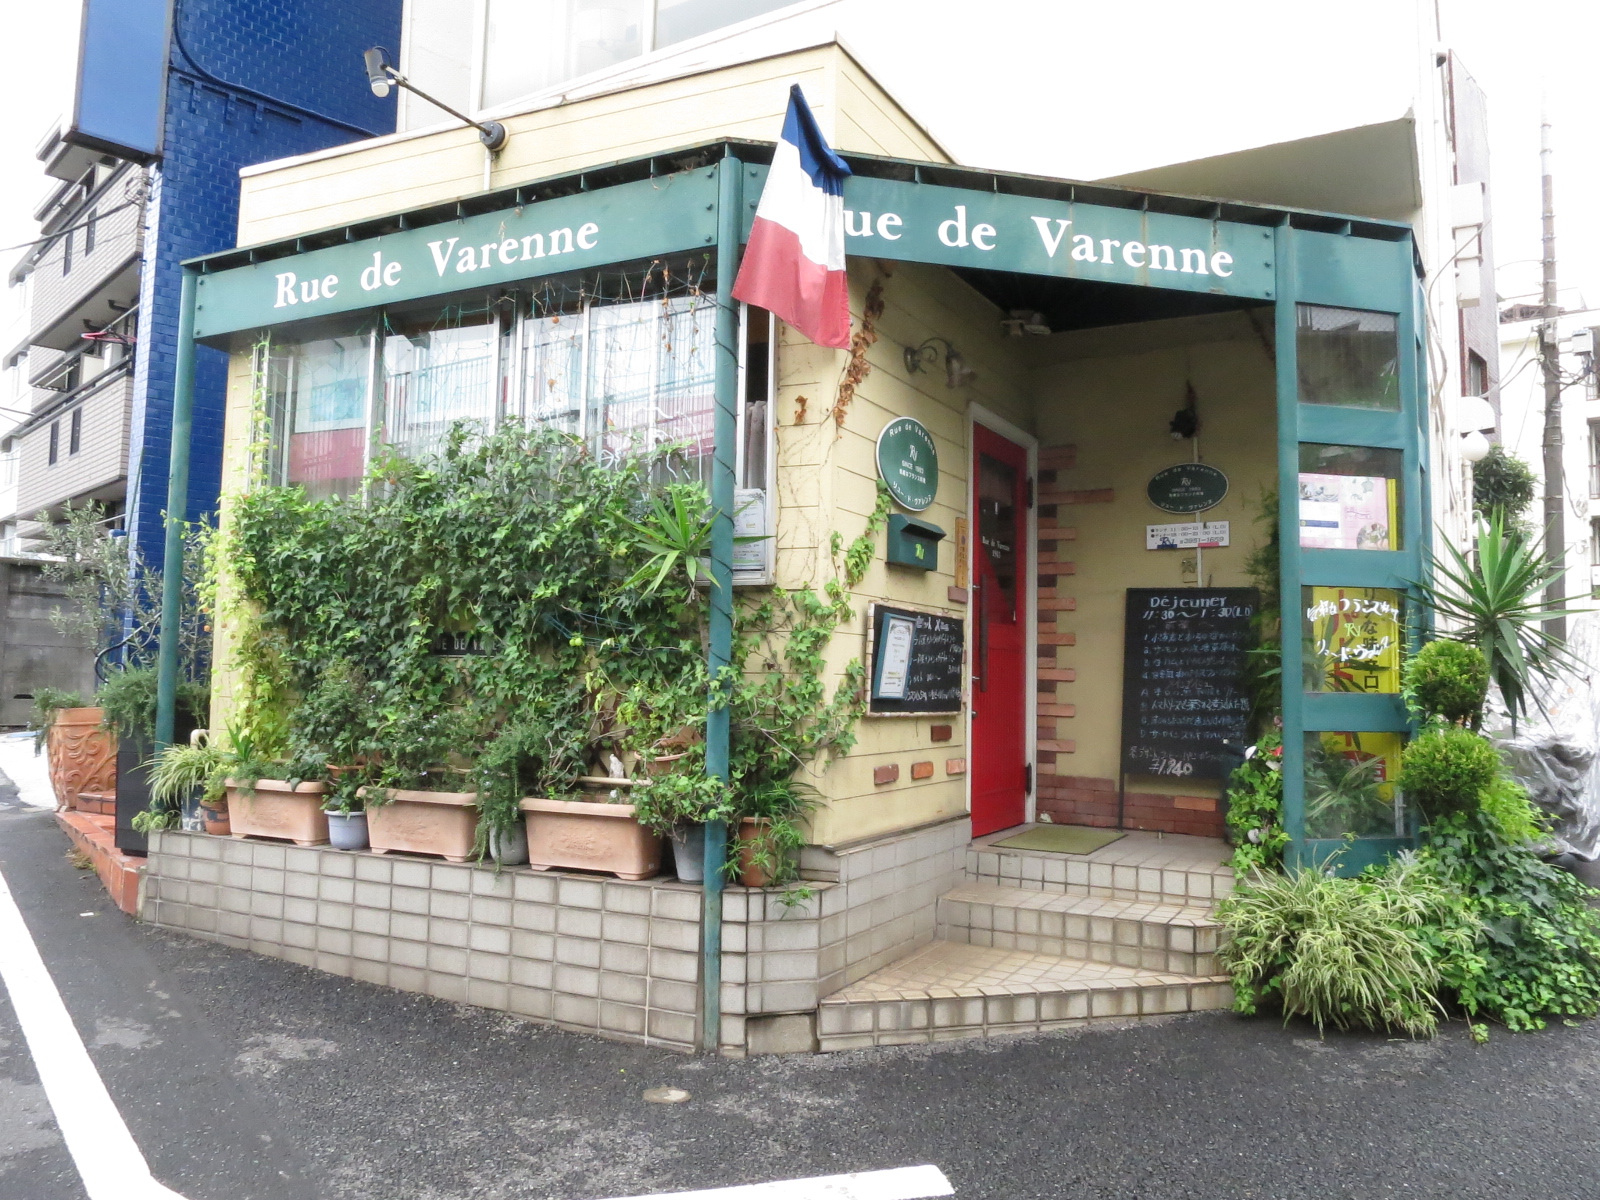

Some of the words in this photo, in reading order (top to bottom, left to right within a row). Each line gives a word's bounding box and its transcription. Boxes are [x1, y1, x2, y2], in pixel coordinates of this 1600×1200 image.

[274, 272, 339, 308] Rue
[360, 251, 402, 292] de
[427, 222, 600, 277] Varenne
[845, 210, 903, 241] ue
[937, 205, 998, 251] de
[1030, 216, 1235, 278] Varenne
[889, 425, 902, 438] Rue
[904, 422, 912, 431] de
